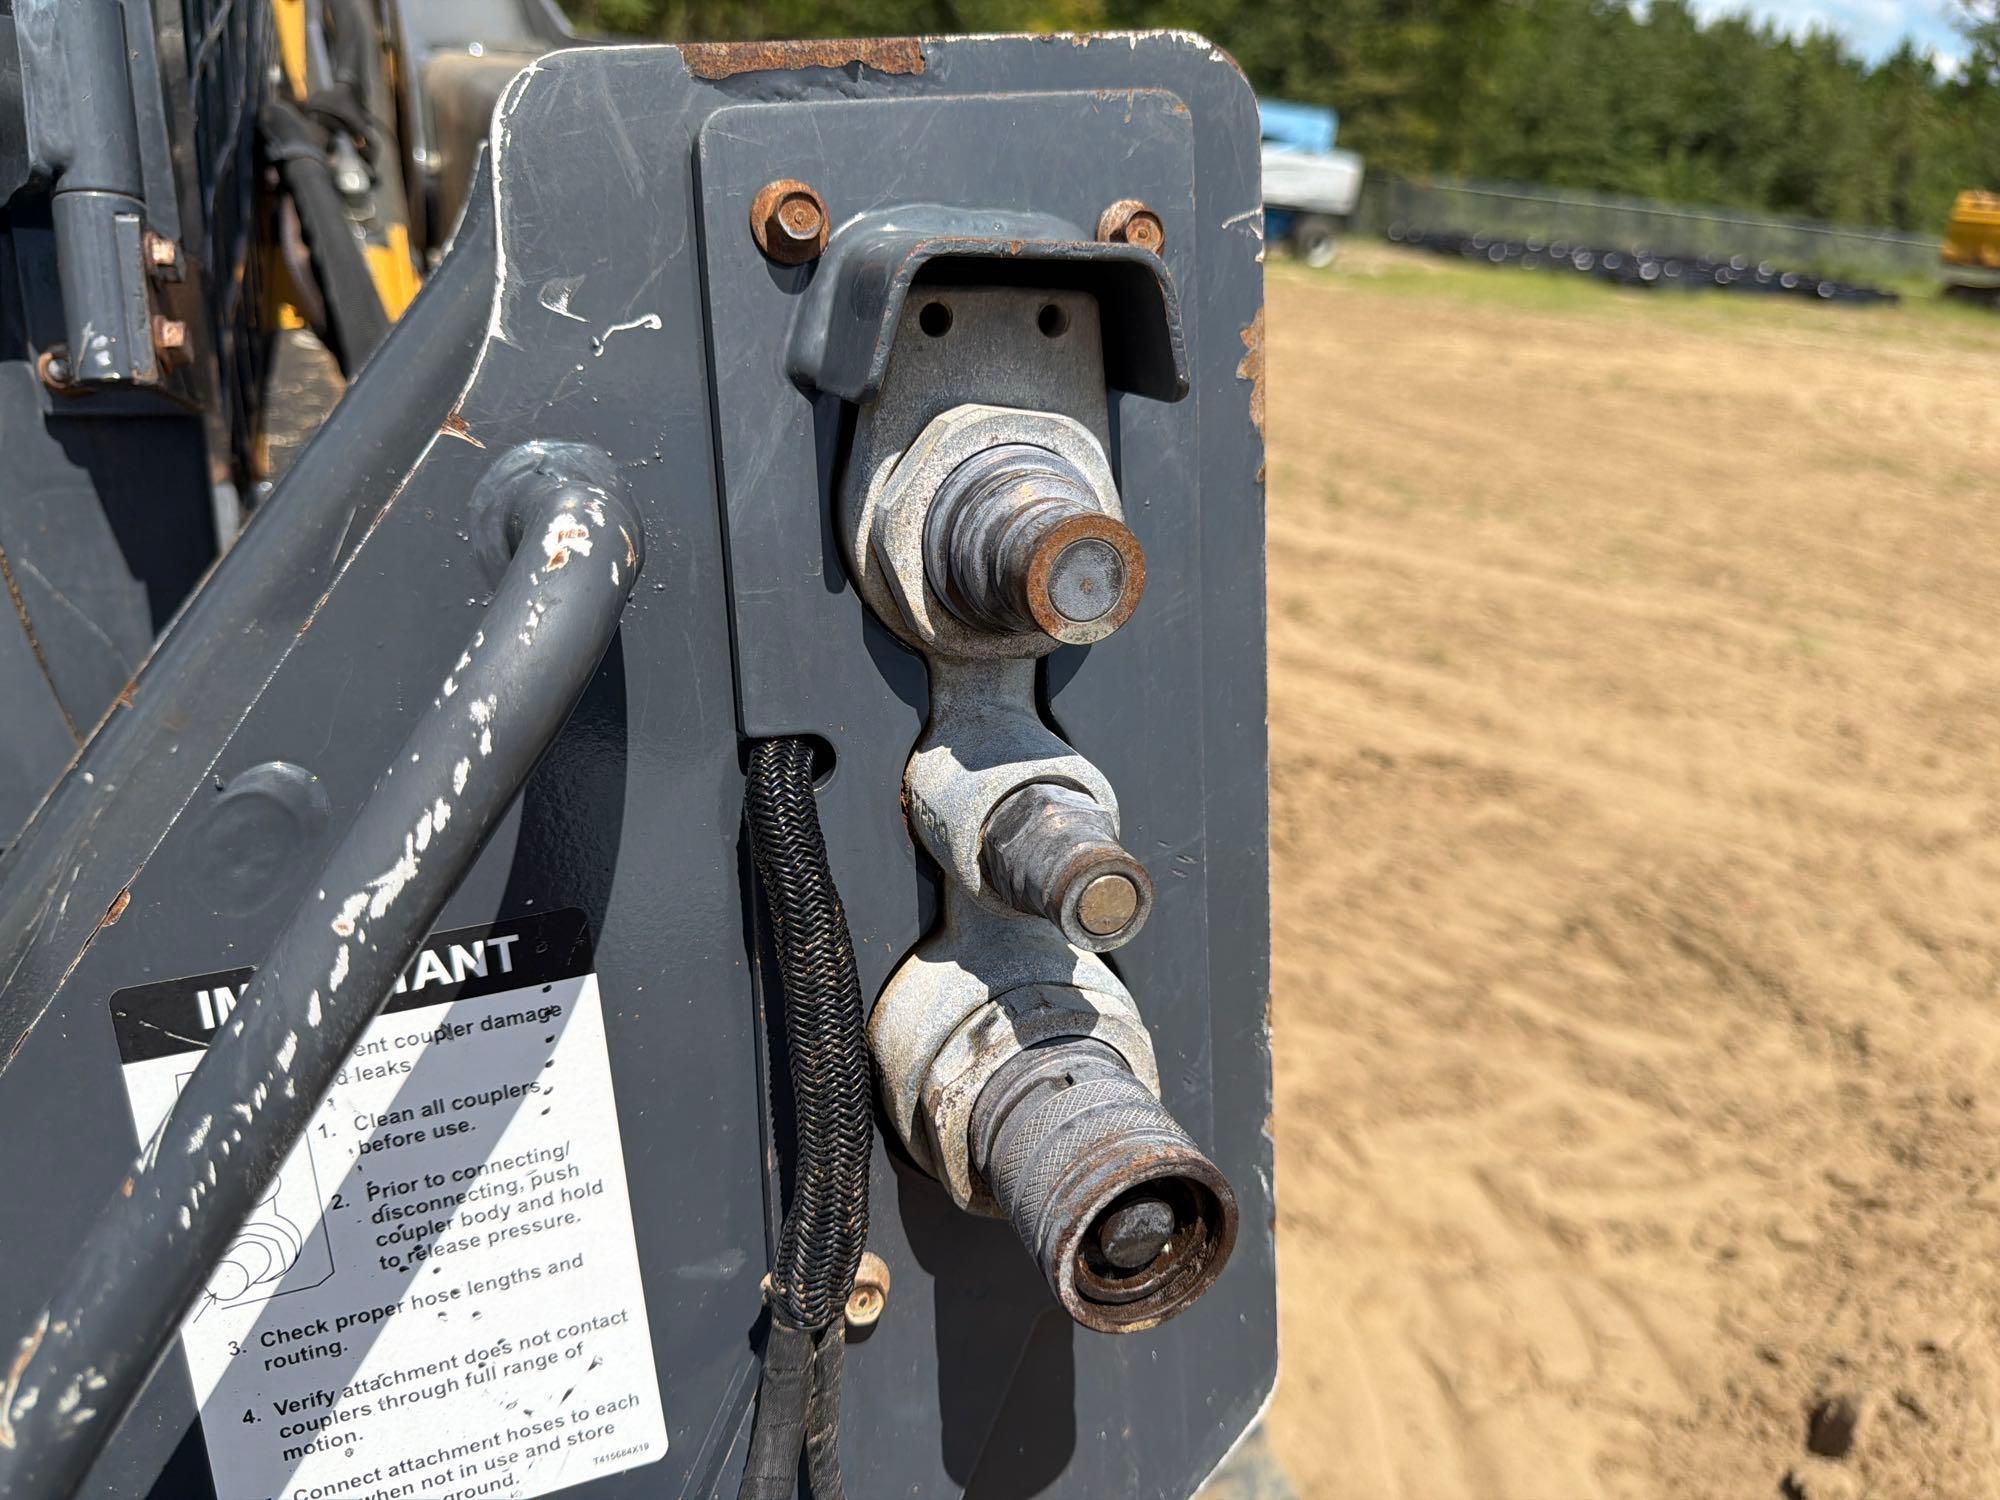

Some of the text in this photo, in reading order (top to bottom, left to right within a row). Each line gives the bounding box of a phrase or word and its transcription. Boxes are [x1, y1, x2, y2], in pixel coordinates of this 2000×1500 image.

[394, 1022, 474, 1046] coupler
[481, 1004, 562, 1032] damage
[356, 1059, 412, 1083] leaks
[318, 1080, 541, 1140] 1. Clean all couplers
[358, 1119, 477, 1156] before use.
[331, 1141, 571, 1211] 2. Prior to connecting/
[371, 1163, 580, 1225] disconnecting, push
[375, 1179, 604, 1247] coupler body and hold
[380, 1214, 581, 1270] to release pressure.
[228, 1252, 584, 1356] 3. Check proper hose lengths and
[242, 1309, 629, 1424] 4. Verify attachment does not contact
[264, 1341, 348, 1371] routing.
[279, 1341, 584, 1439] couplers through full range of
[283, 1432, 364, 1461] motion.
[294, 1393, 640, 1500] Connect attachment hoses to each
[421, 1469, 454, 1489] not
[460, 1464, 477, 1479] in
[484, 1452, 519, 1471] use
[525, 1436, 561, 1459] and
[567, 1423, 615, 1447] store
